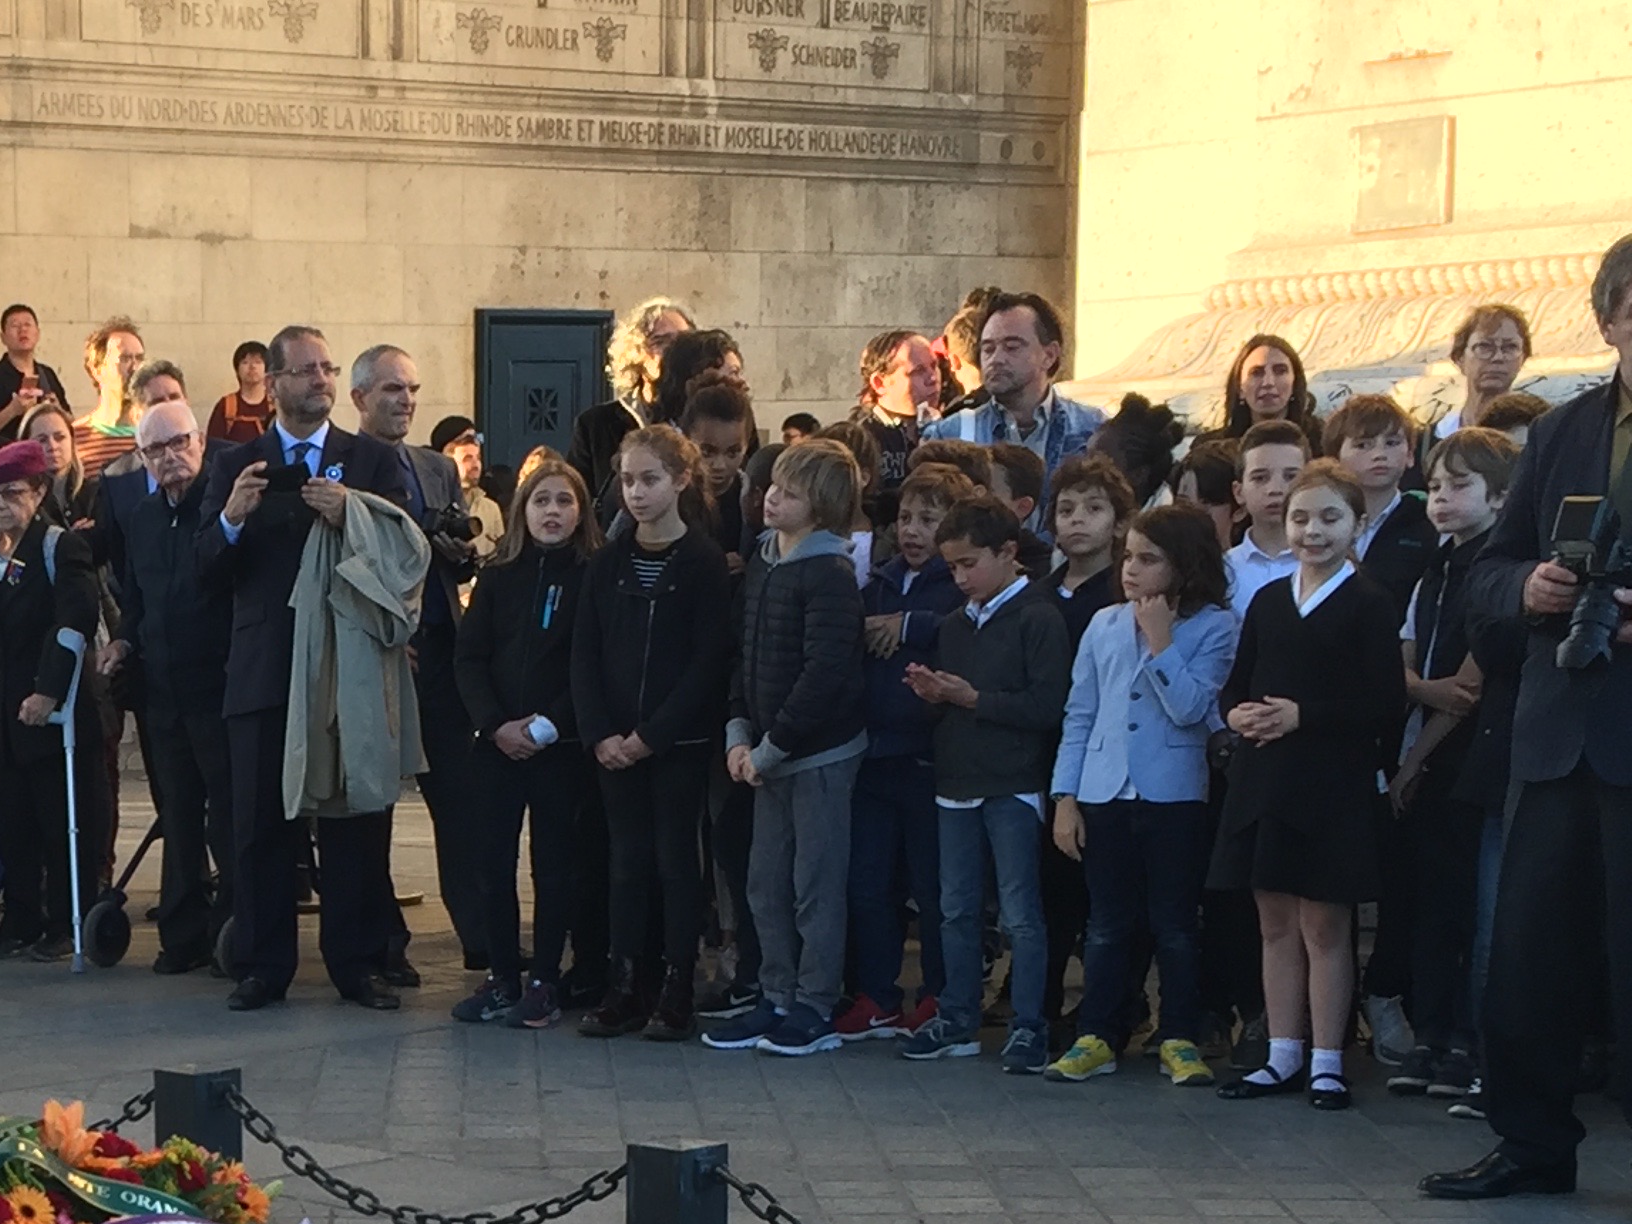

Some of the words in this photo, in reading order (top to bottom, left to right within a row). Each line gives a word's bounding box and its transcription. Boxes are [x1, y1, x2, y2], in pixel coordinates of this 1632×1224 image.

[221, 4, 264, 31] MARS
[833, 0, 927, 27] BEAUREPAIRE
[791, 44, 857, 69] SCHNEIDER
[110, 94, 132, 120] DU
[334, 107, 354, 131] LA
[517, 116, 572, 141] SAMBRE
[577, 119, 595, 142] ET
[704, 124, 721, 148] ET
